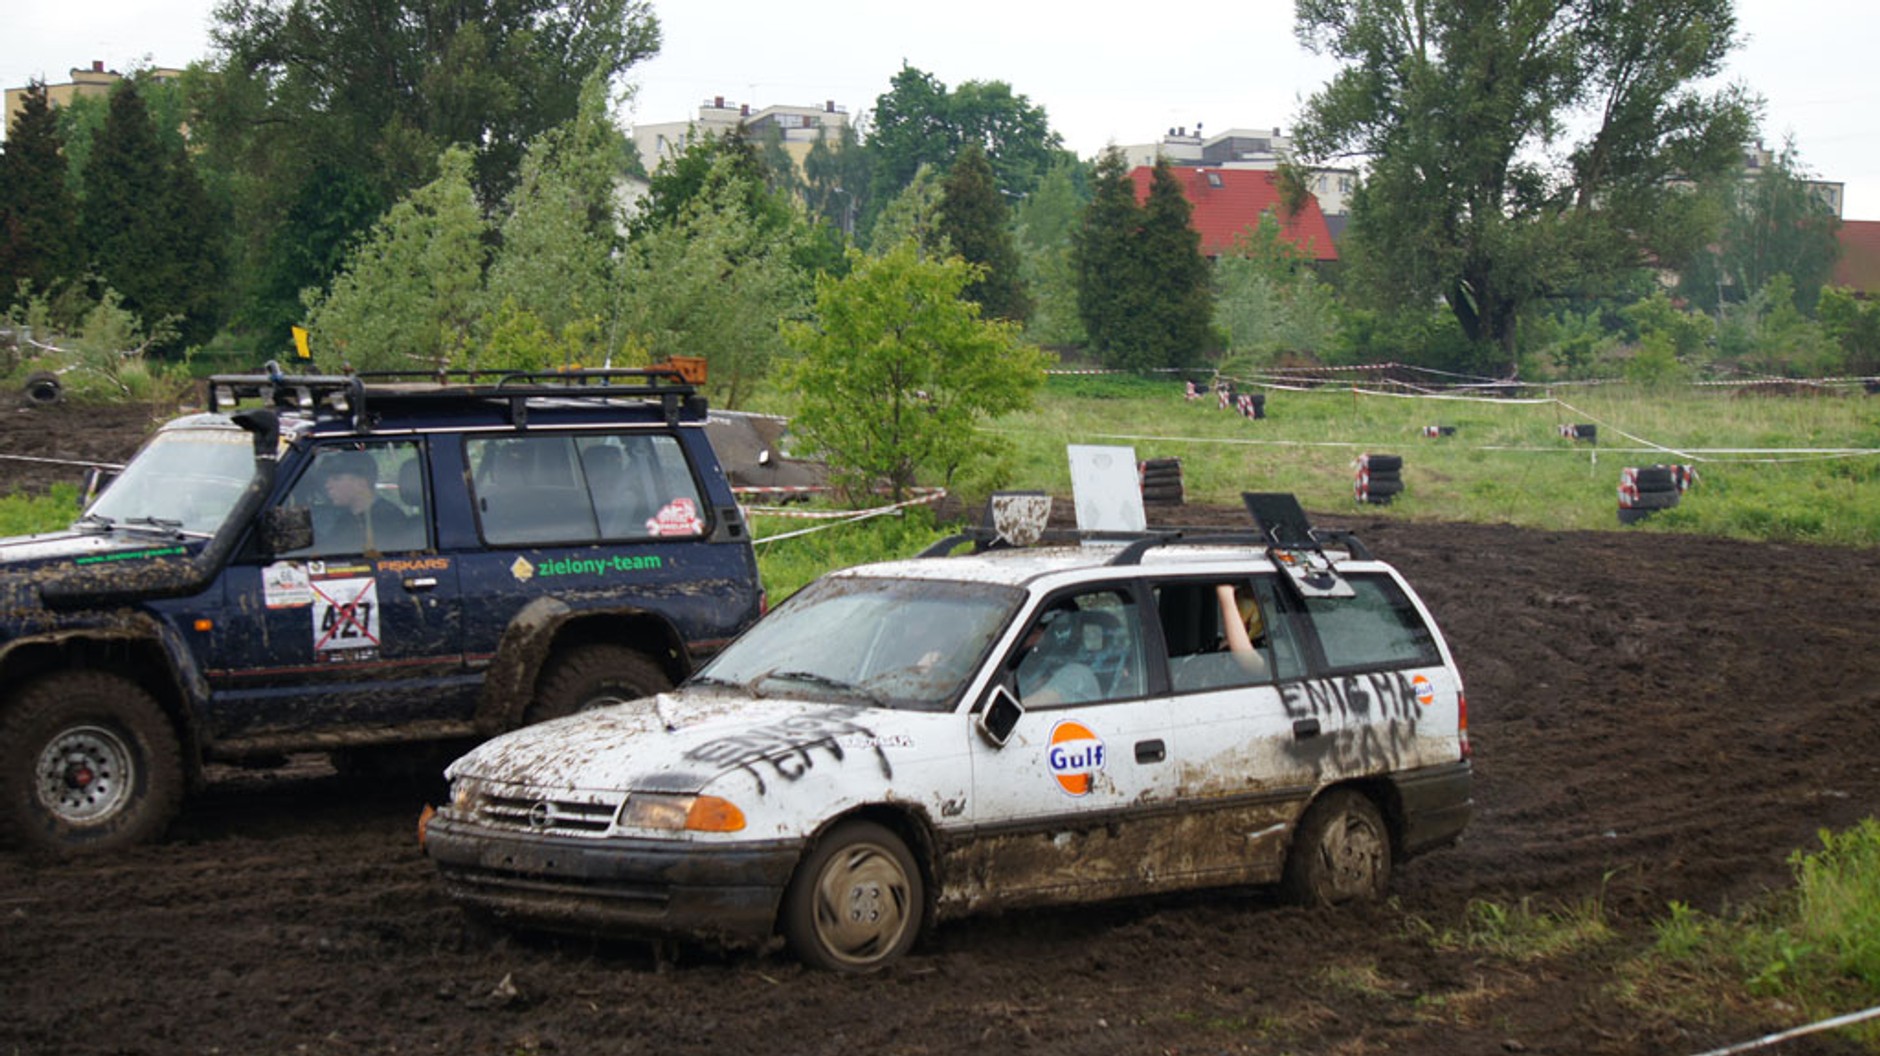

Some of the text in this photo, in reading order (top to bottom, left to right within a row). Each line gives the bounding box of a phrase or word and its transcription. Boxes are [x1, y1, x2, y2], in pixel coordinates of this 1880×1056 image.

[377, 558, 449, 572] FISKARS
[538, 554, 662, 576] zielony-team
[321, 602, 371, 640] 427
[1050, 745, 1103, 769] Gulf
